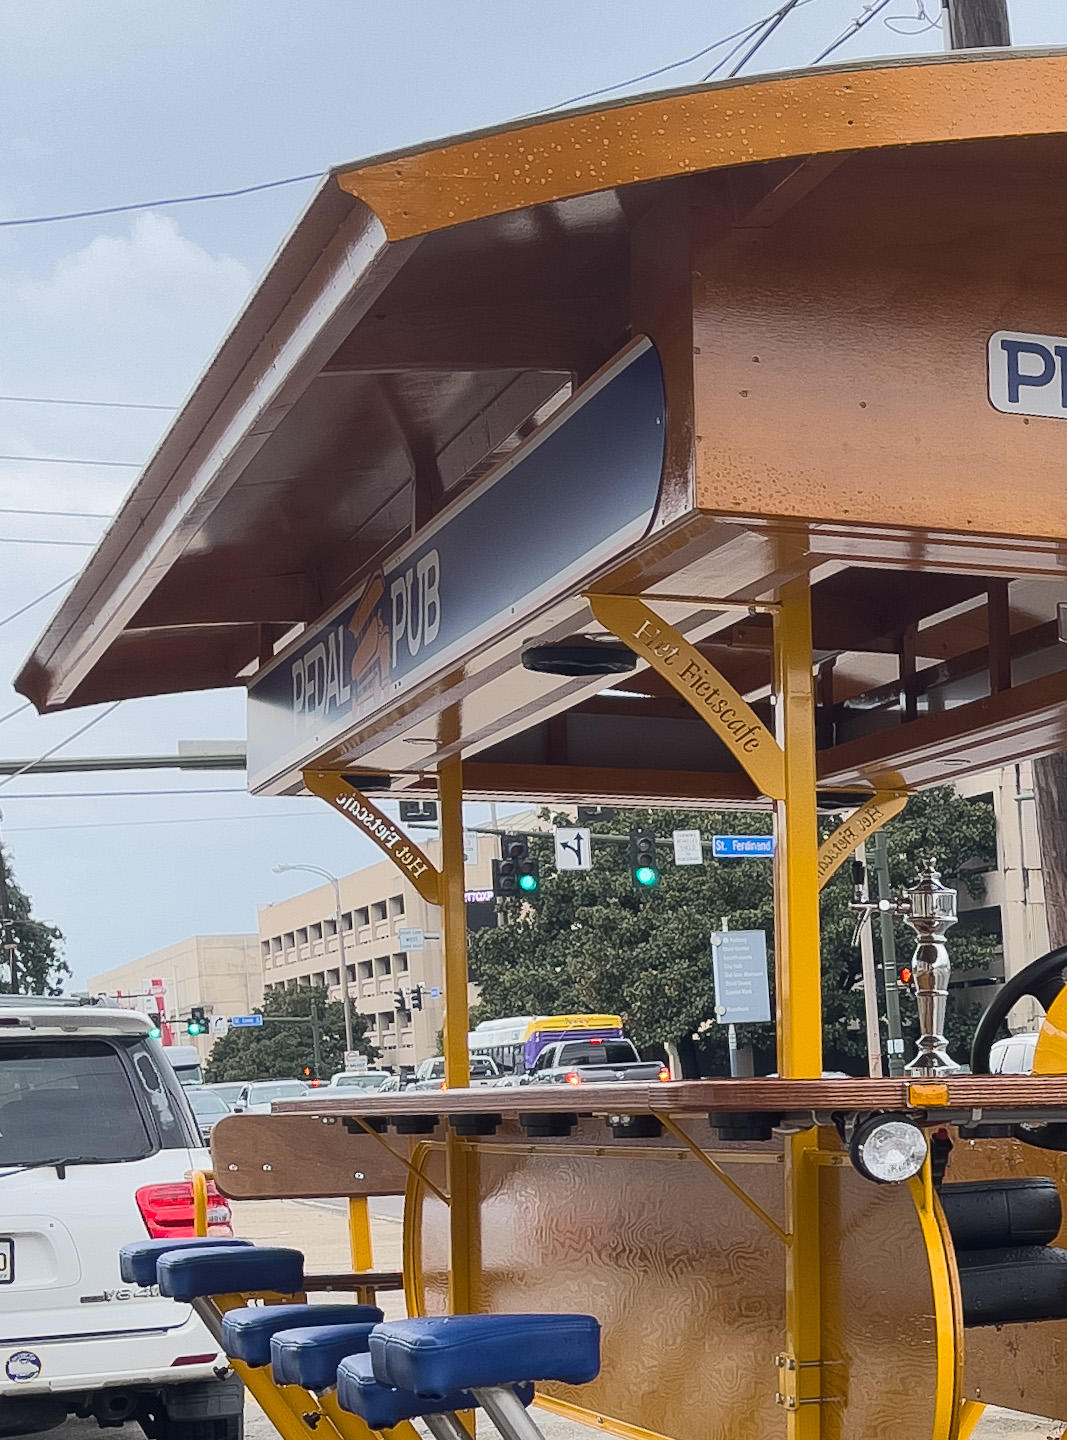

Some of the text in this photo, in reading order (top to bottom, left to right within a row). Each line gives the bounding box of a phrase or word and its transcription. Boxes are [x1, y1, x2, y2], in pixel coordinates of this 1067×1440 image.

[291, 548, 441, 728] PEDAL PUB
[631, 619, 762, 754] Het Fietscafe
[715, 839, 771, 851] St. Ferdinand
